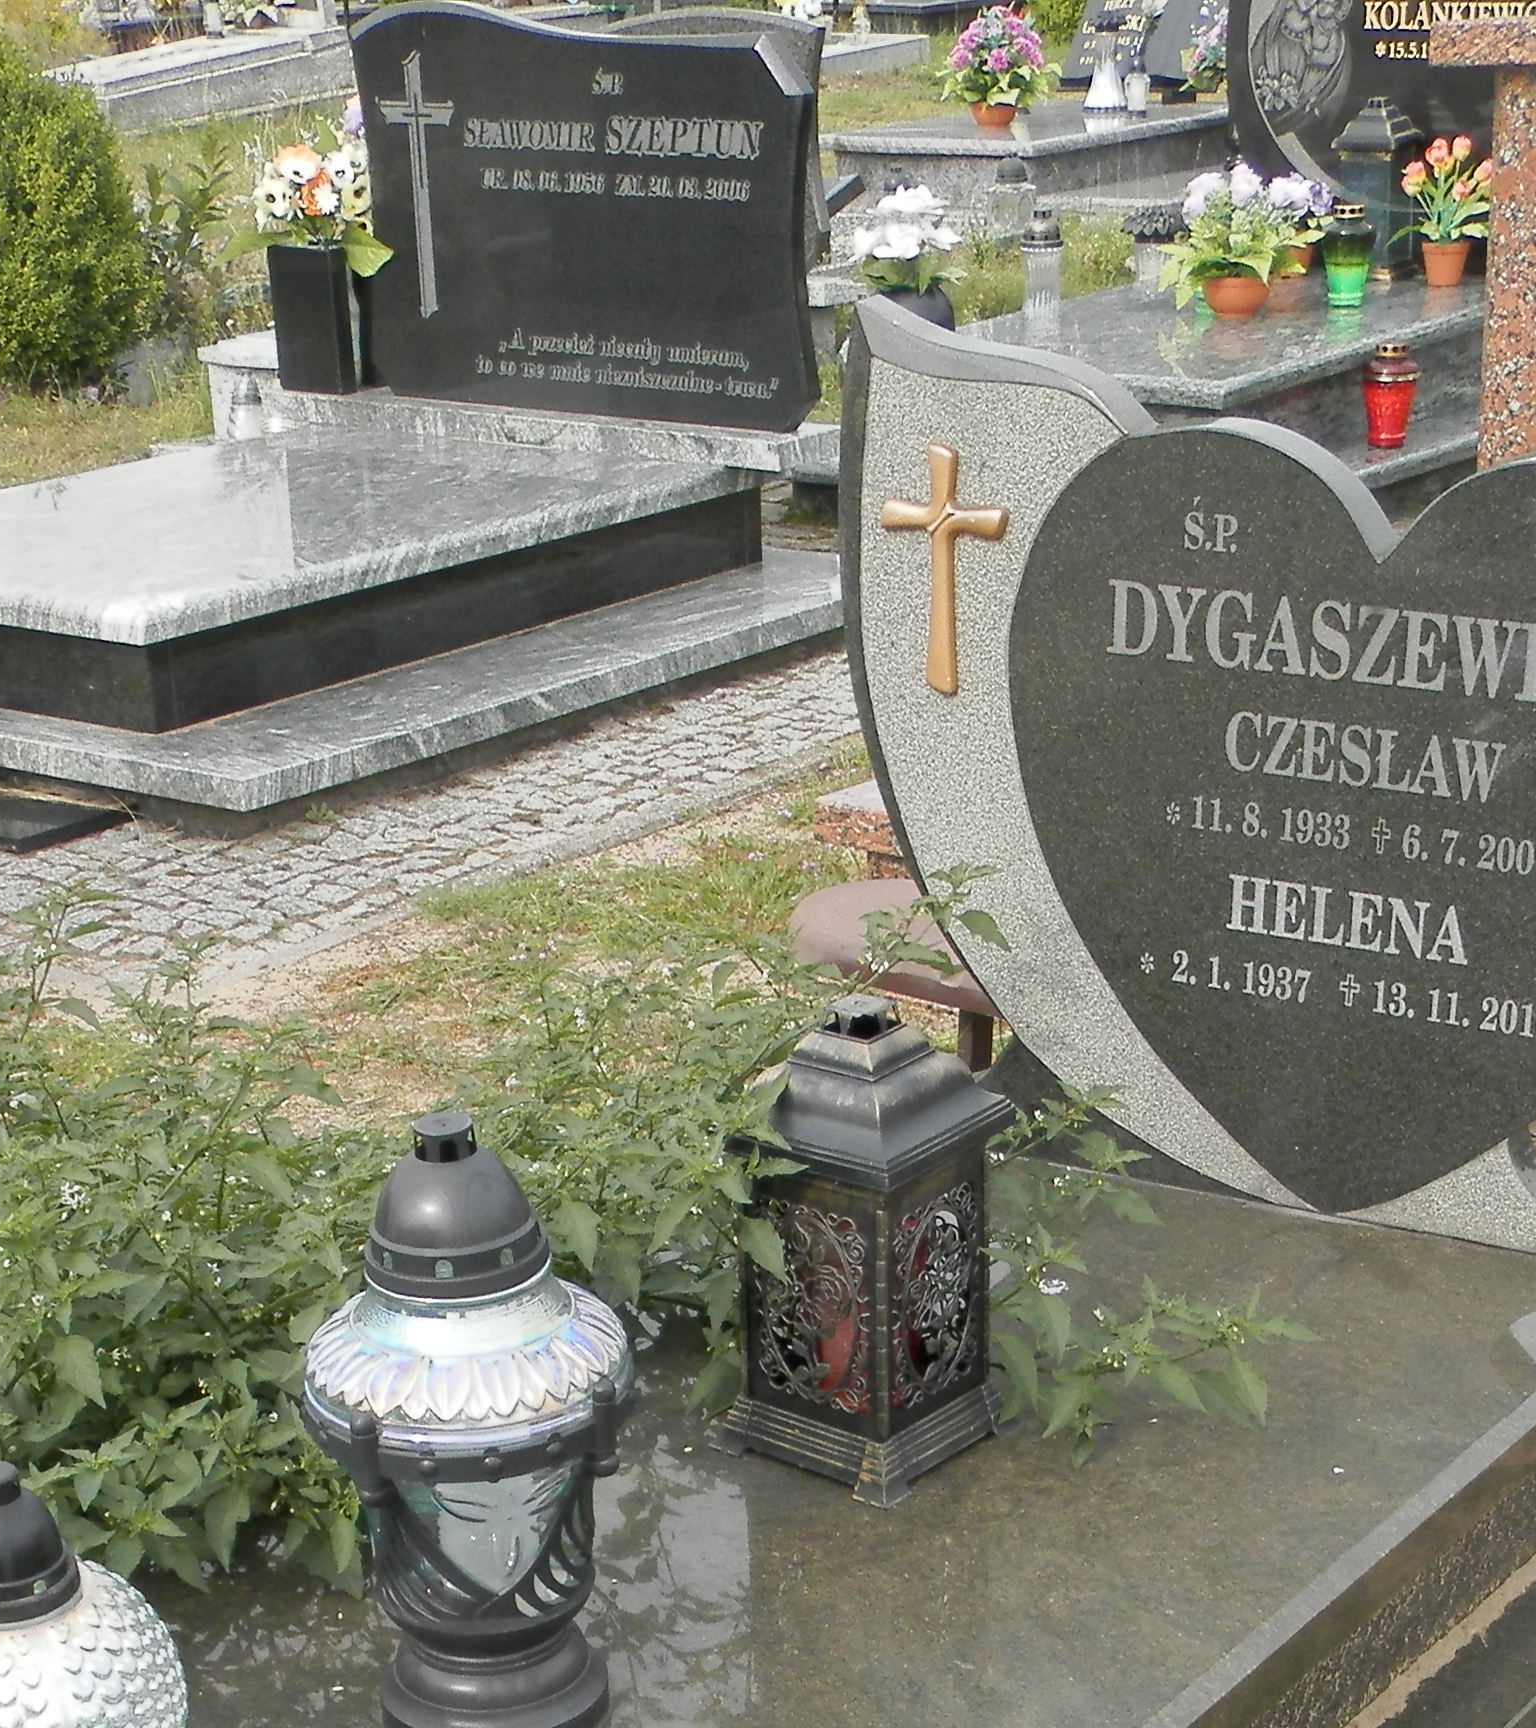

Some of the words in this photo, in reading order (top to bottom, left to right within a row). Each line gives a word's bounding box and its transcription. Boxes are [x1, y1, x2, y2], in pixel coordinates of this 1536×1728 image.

[463, 118, 595, 152] SŁAWOMIR
[605, 115, 764, 161] SZEPTUN
[1182, 495, 1239, 554] Ś.P.
[1225, 709, 1507, 804] CZESŁAW
[1225, 873, 1468, 967] HELENA
